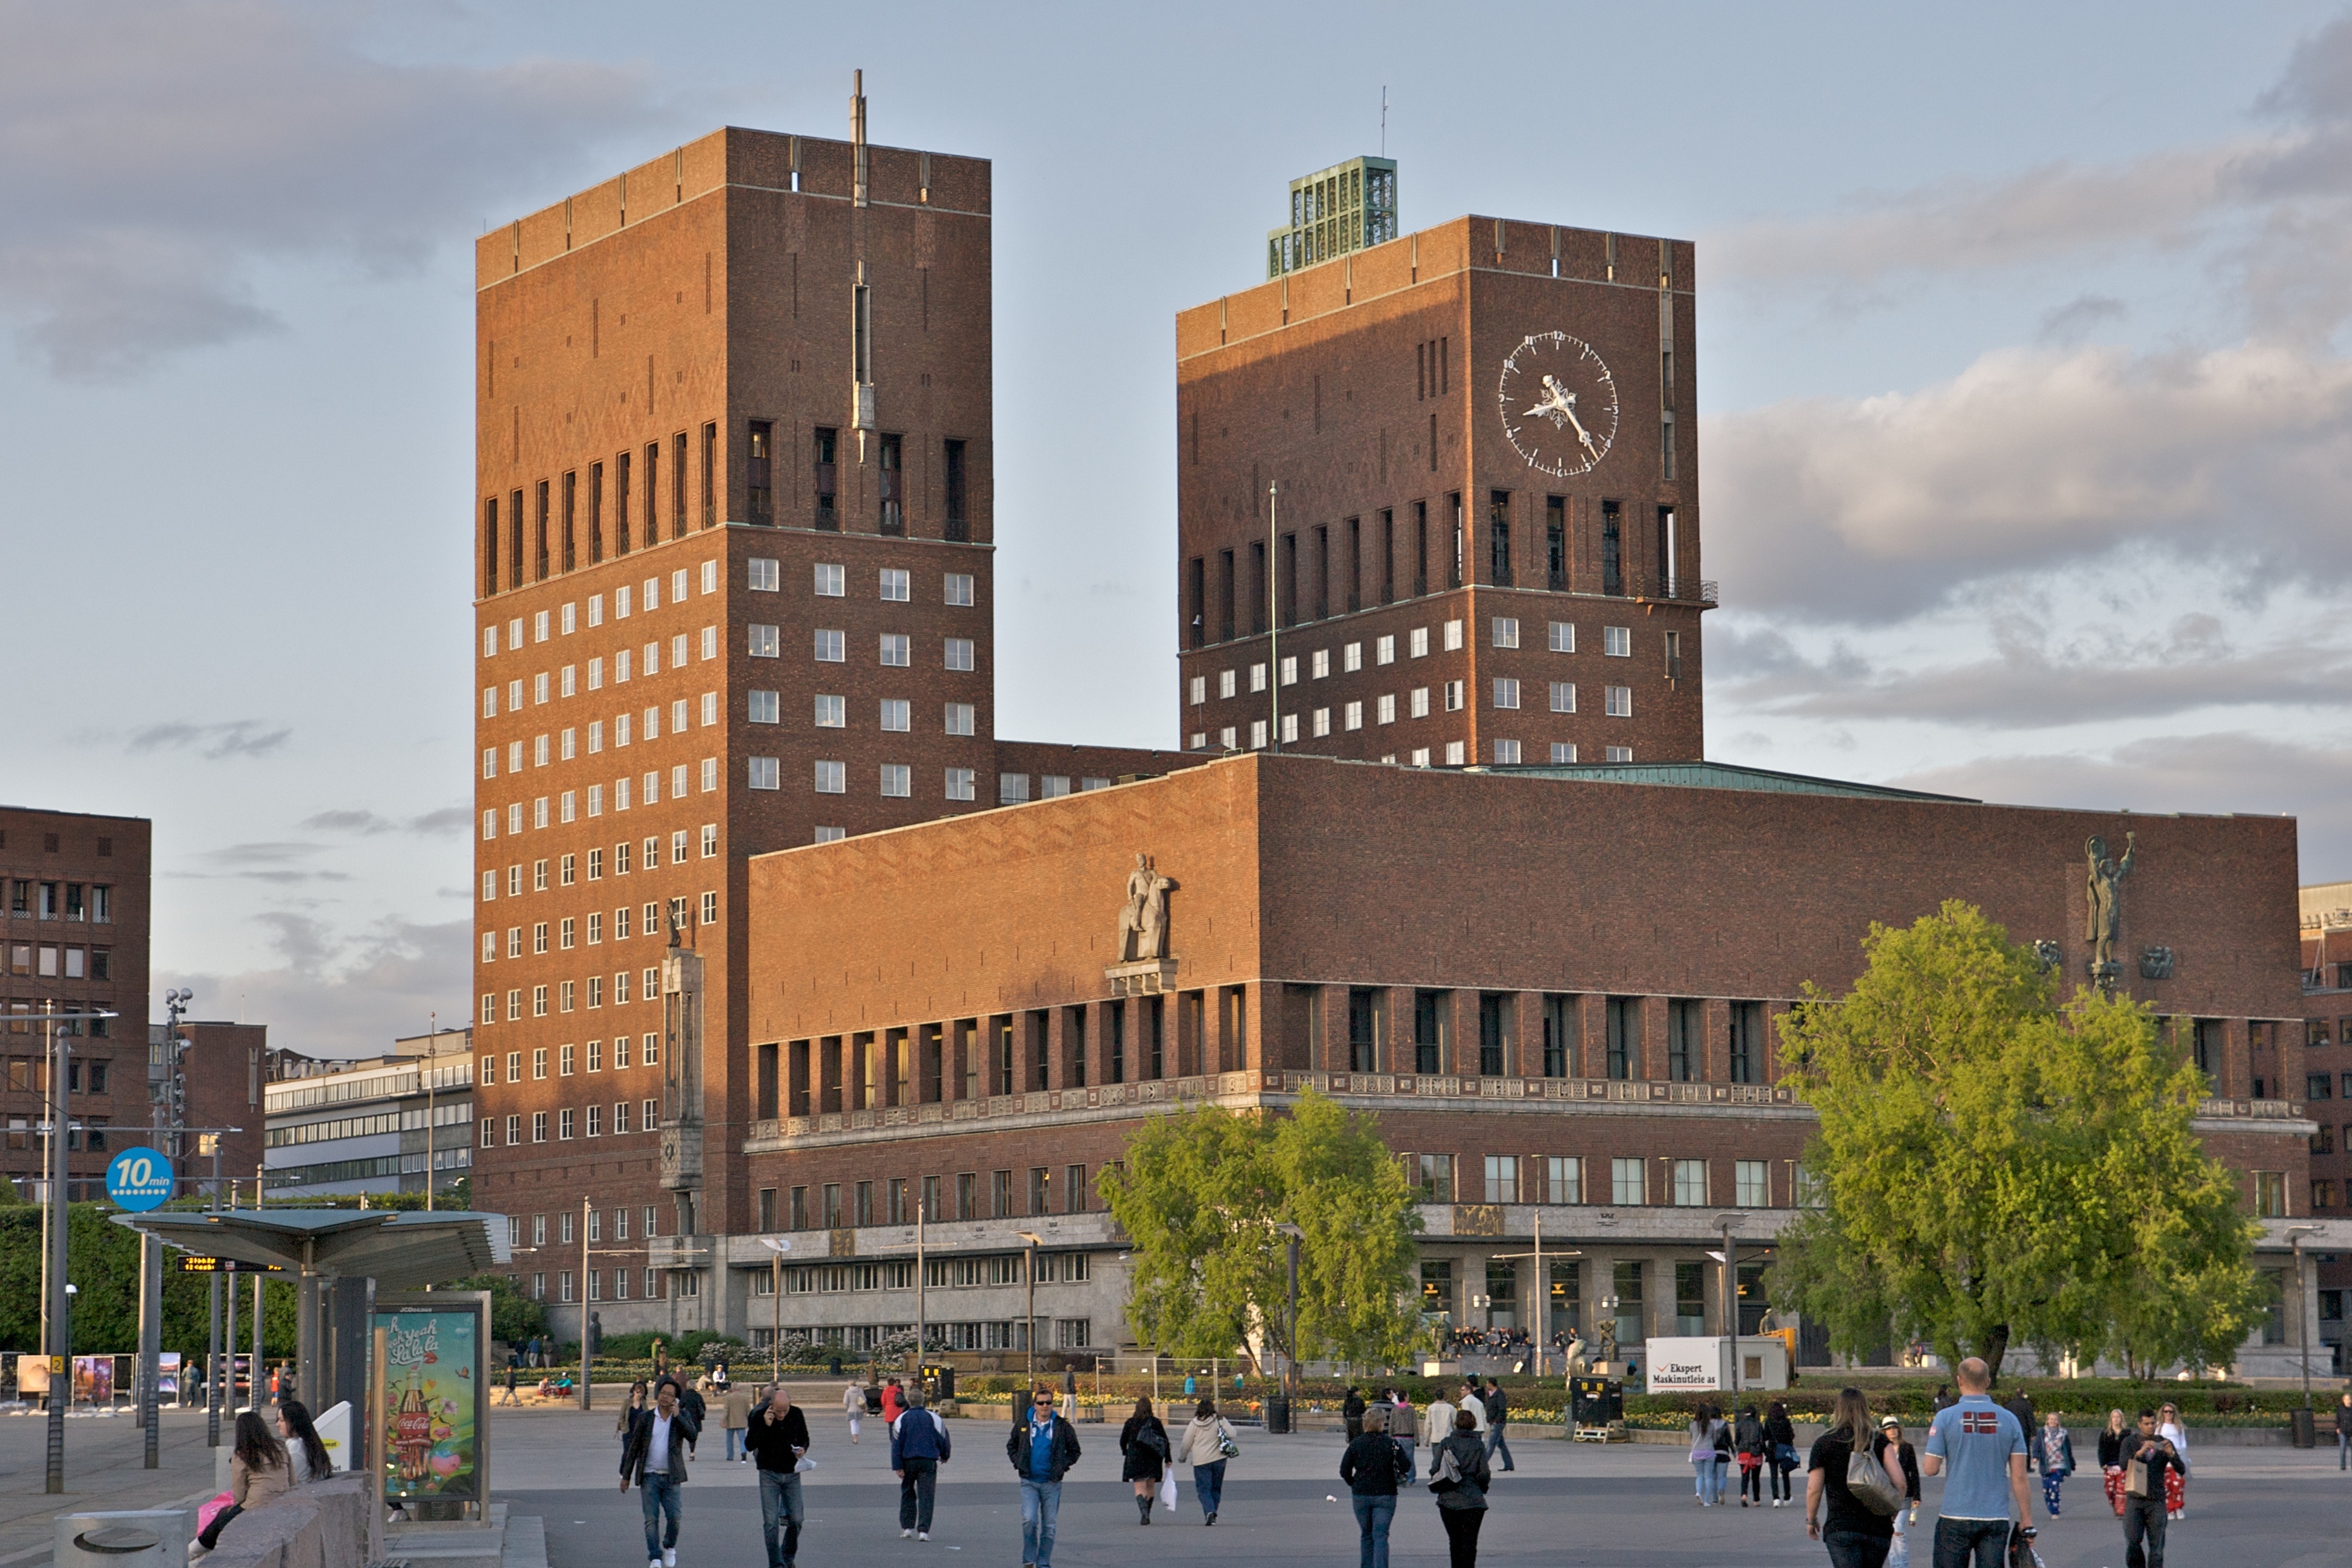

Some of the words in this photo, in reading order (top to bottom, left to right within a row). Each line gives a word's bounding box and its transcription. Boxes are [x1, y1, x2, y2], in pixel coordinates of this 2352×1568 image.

[1524, 335, 1533, 345] 11
[1553, 331, 1563, 340] 12
[1584, 343, 1589, 352] 1
[1504, 359, 1514, 369] 10
[1604, 371, 1611, 379] 2
[1498, 393, 1505, 402] 9
[1612, 405, 1619, 415] 3
[1506, 429, 1512, 438] 8
[1605, 439, 1611, 448] 4
[1528, 457, 1534, 466] 7
[1585, 463, 1591, 472] 5
[1557, 469, 1563, 477] 6
[116, 1158, 152, 1187] 10
[149, 1176, 169, 1186] min
[424, 1335, 439, 1352] la
[54, 1360, 61, 1371] 2
[1670, 1363, 1702, 1375] Ekspert
[1653, 1375, 1705, 1383] Maskinutleie
